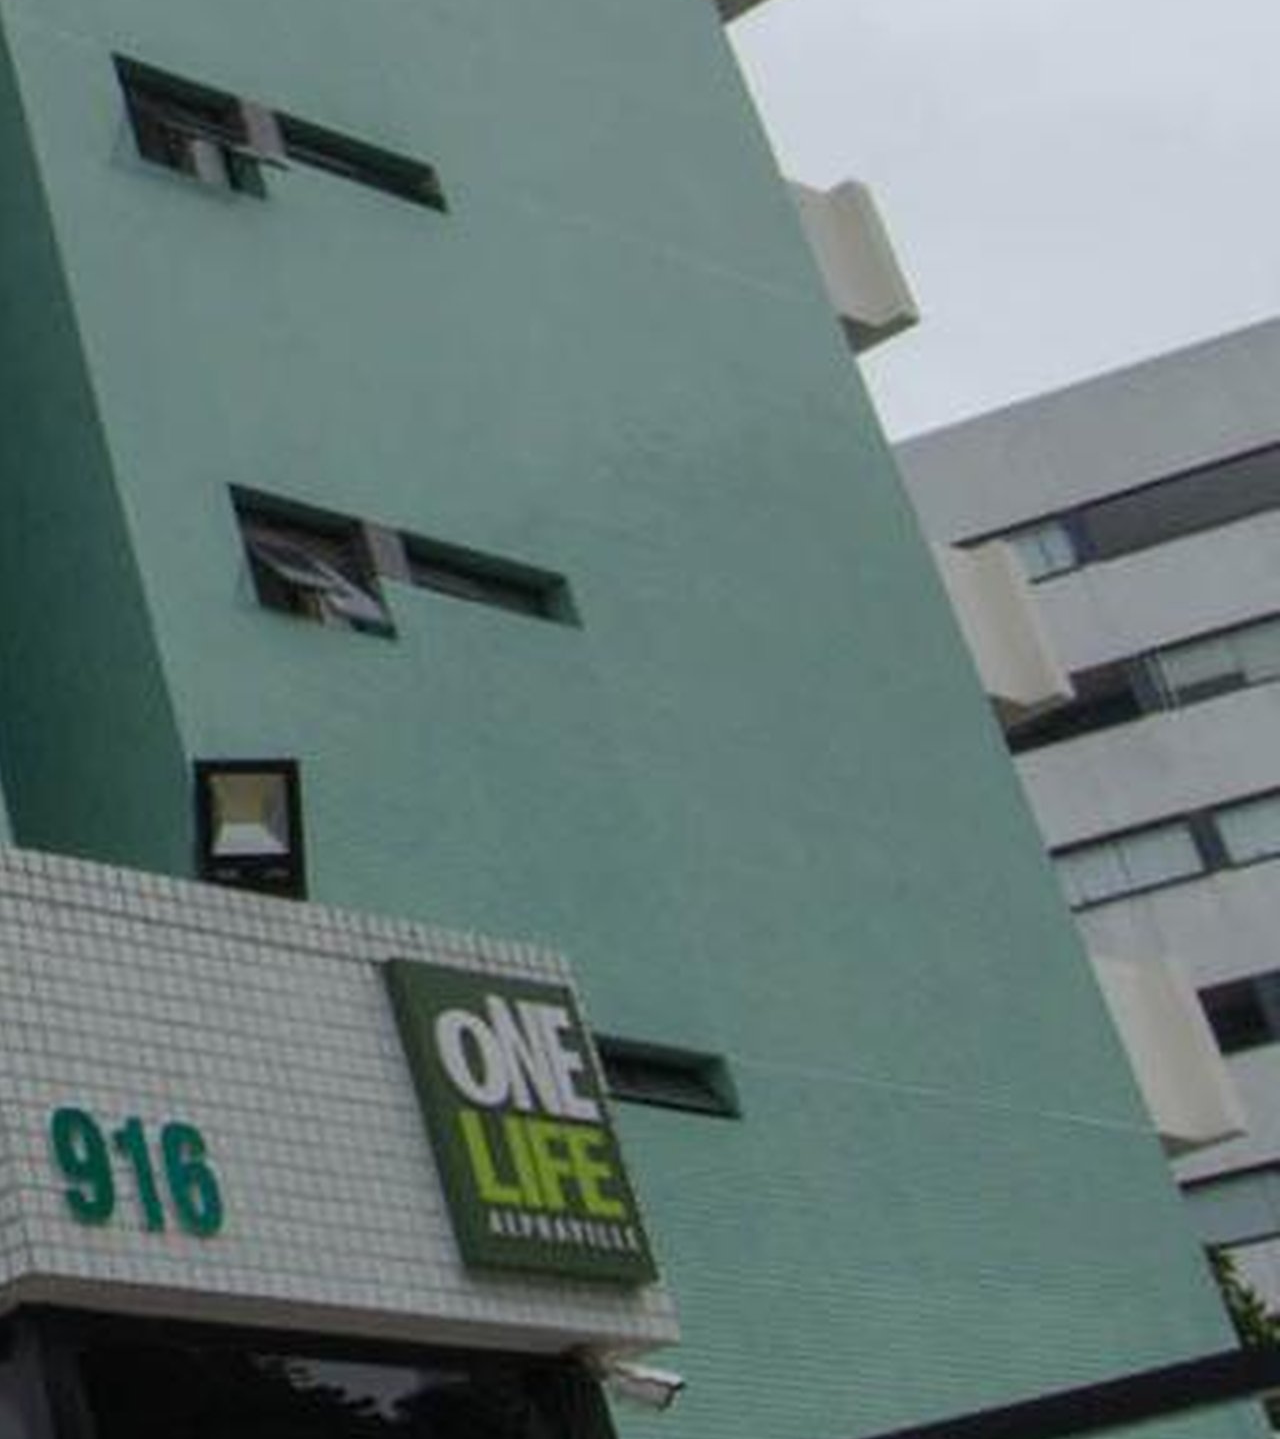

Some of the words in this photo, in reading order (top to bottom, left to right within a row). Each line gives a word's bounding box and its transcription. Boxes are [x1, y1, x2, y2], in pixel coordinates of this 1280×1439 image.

[435, 994, 603, 1122] ONE
[52, 1107, 224, 1239] 916
[458, 1109, 627, 1220] LIFE
